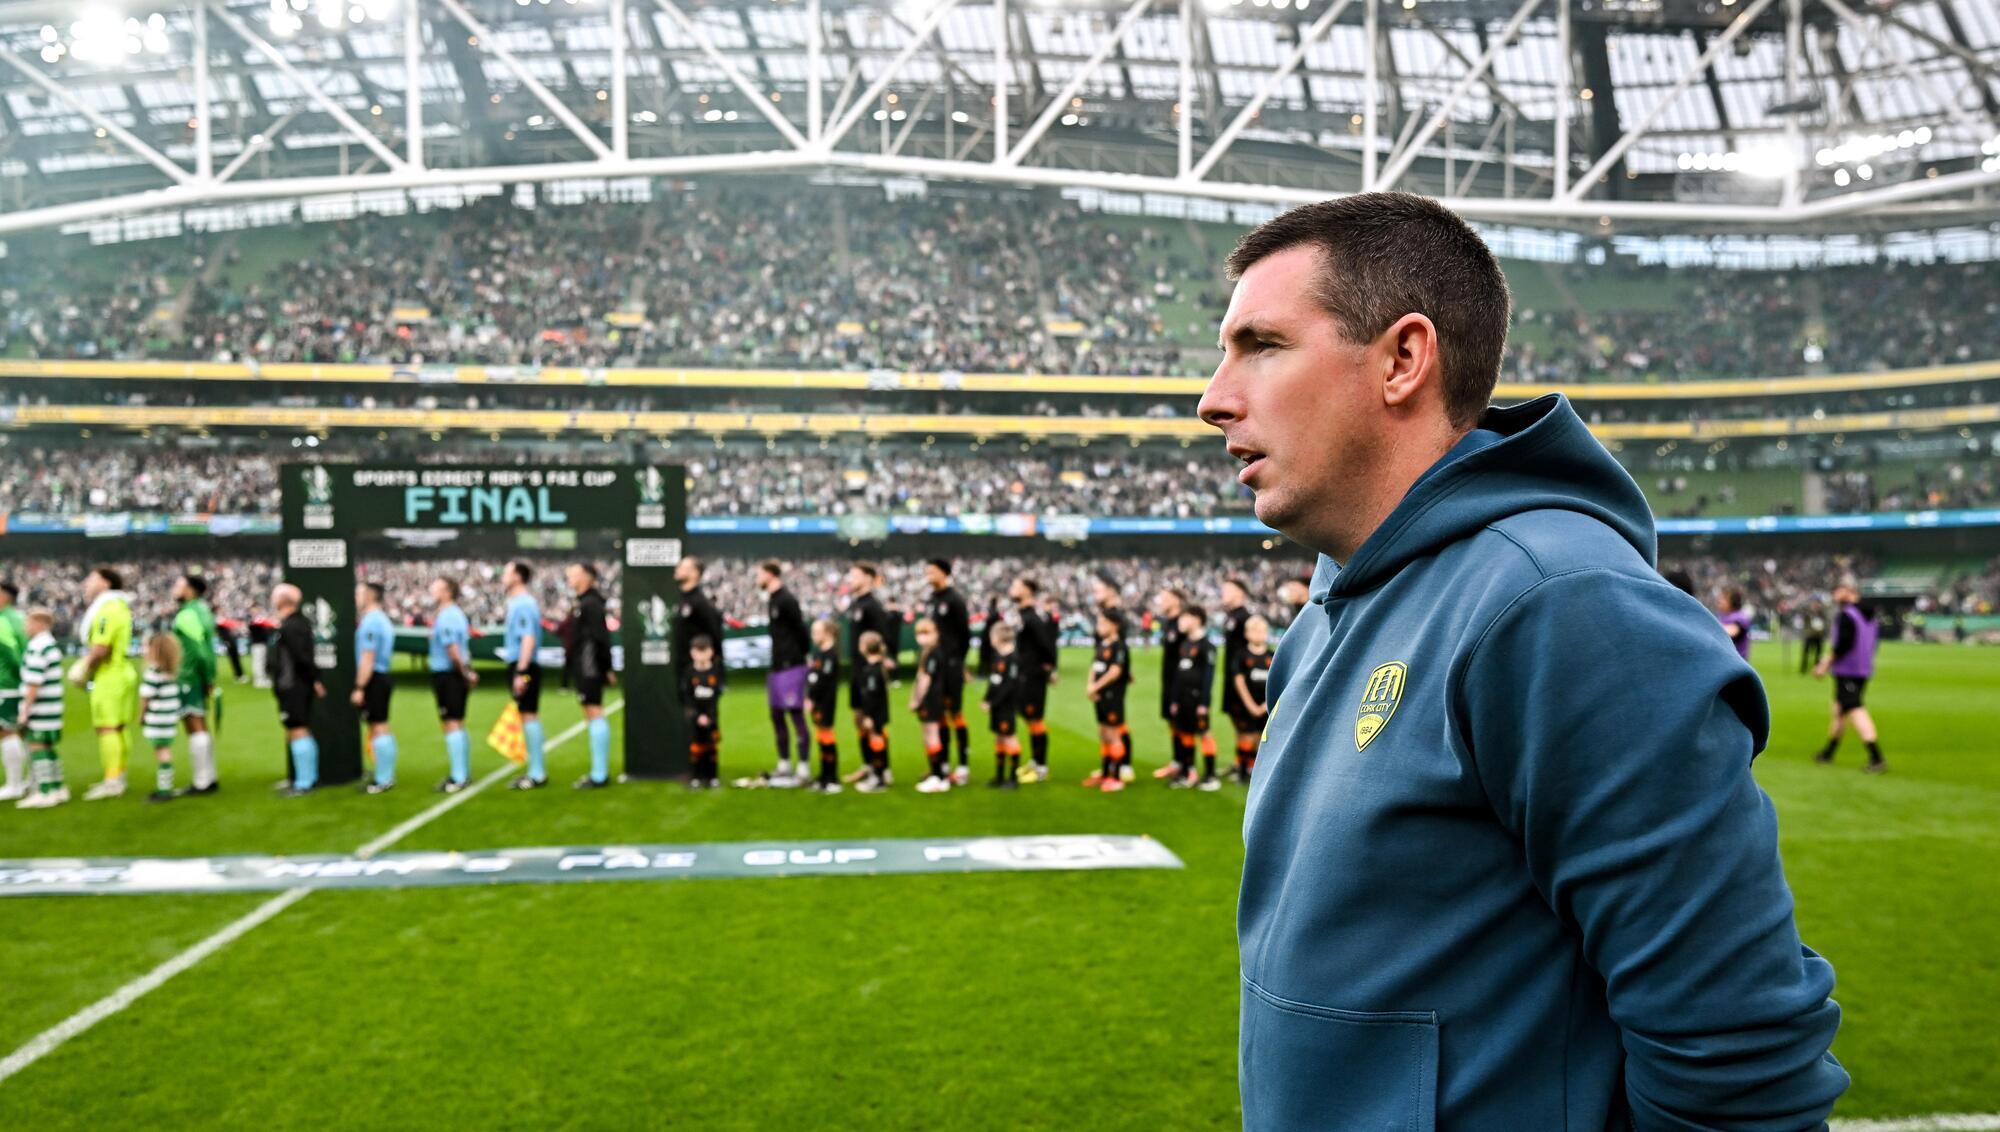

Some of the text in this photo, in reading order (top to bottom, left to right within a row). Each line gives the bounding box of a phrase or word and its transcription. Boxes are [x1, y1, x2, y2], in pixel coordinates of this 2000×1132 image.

[353, 470, 418, 487] SPORTS
[421, 470, 485, 487] DIRECT
[583, 470, 617, 487] CUP
[405, 486, 567, 523] FINAL
[1360, 703, 1392, 713] CORK CITY
[743, 848, 877, 864] CUP
